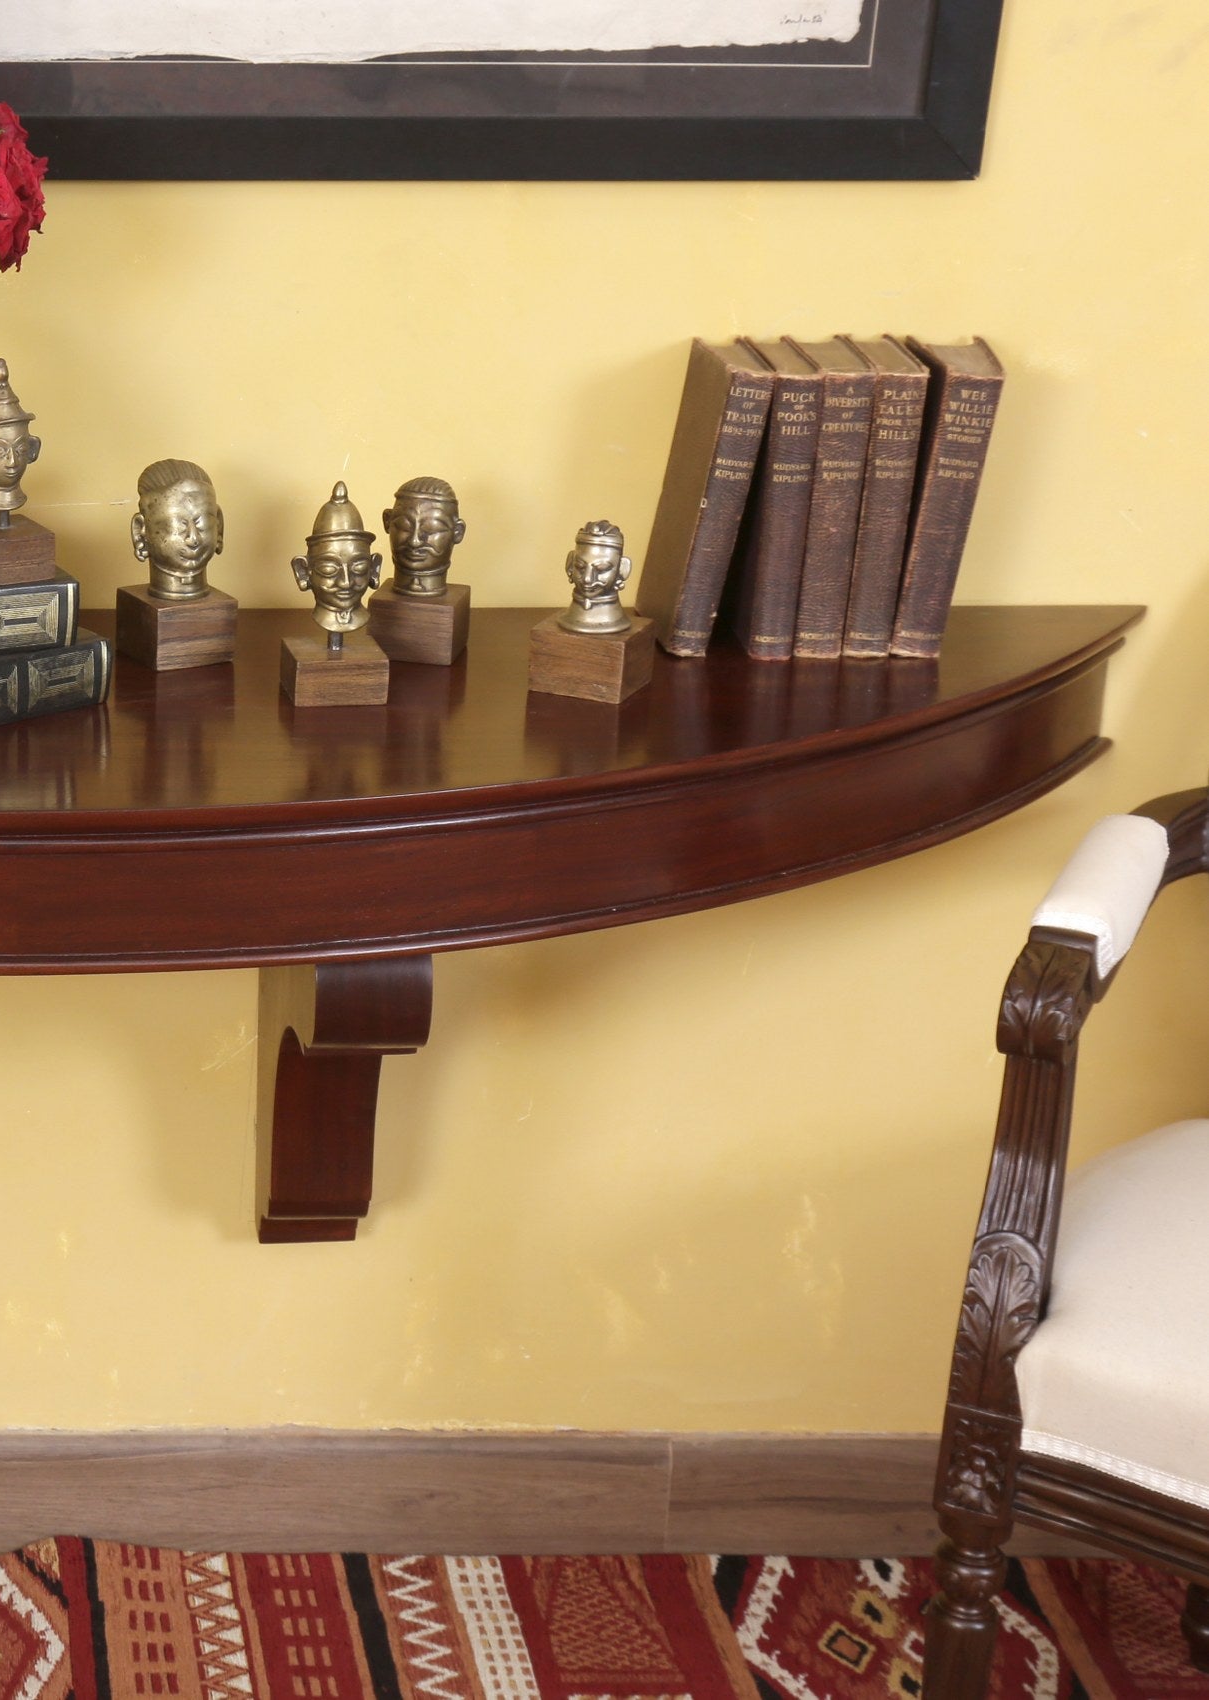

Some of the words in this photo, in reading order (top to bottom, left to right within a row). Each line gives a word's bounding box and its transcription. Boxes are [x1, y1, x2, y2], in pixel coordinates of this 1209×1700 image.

[846, 386, 854, 396] A
[883, 390, 920, 400] PLAIN
[961, 389, 987, 401] WEE
[782, 392, 816, 402] PUCK
[878, 404, 922, 416] TALES
[949, 400, 994, 415] WILLIE
[944, 413, 993, 428] WINKIE
[782, 425, 811, 435] HILL
[878, 429, 917, 440] HILLS
[773, 463, 810, 471] RUDYARD
[715, 469, 750, 480] KIPLING
[773, 474, 809, 482] KIPLING
[822, 471, 859, 480] KIPLING
[938, 469, 975, 480] KIPLING
